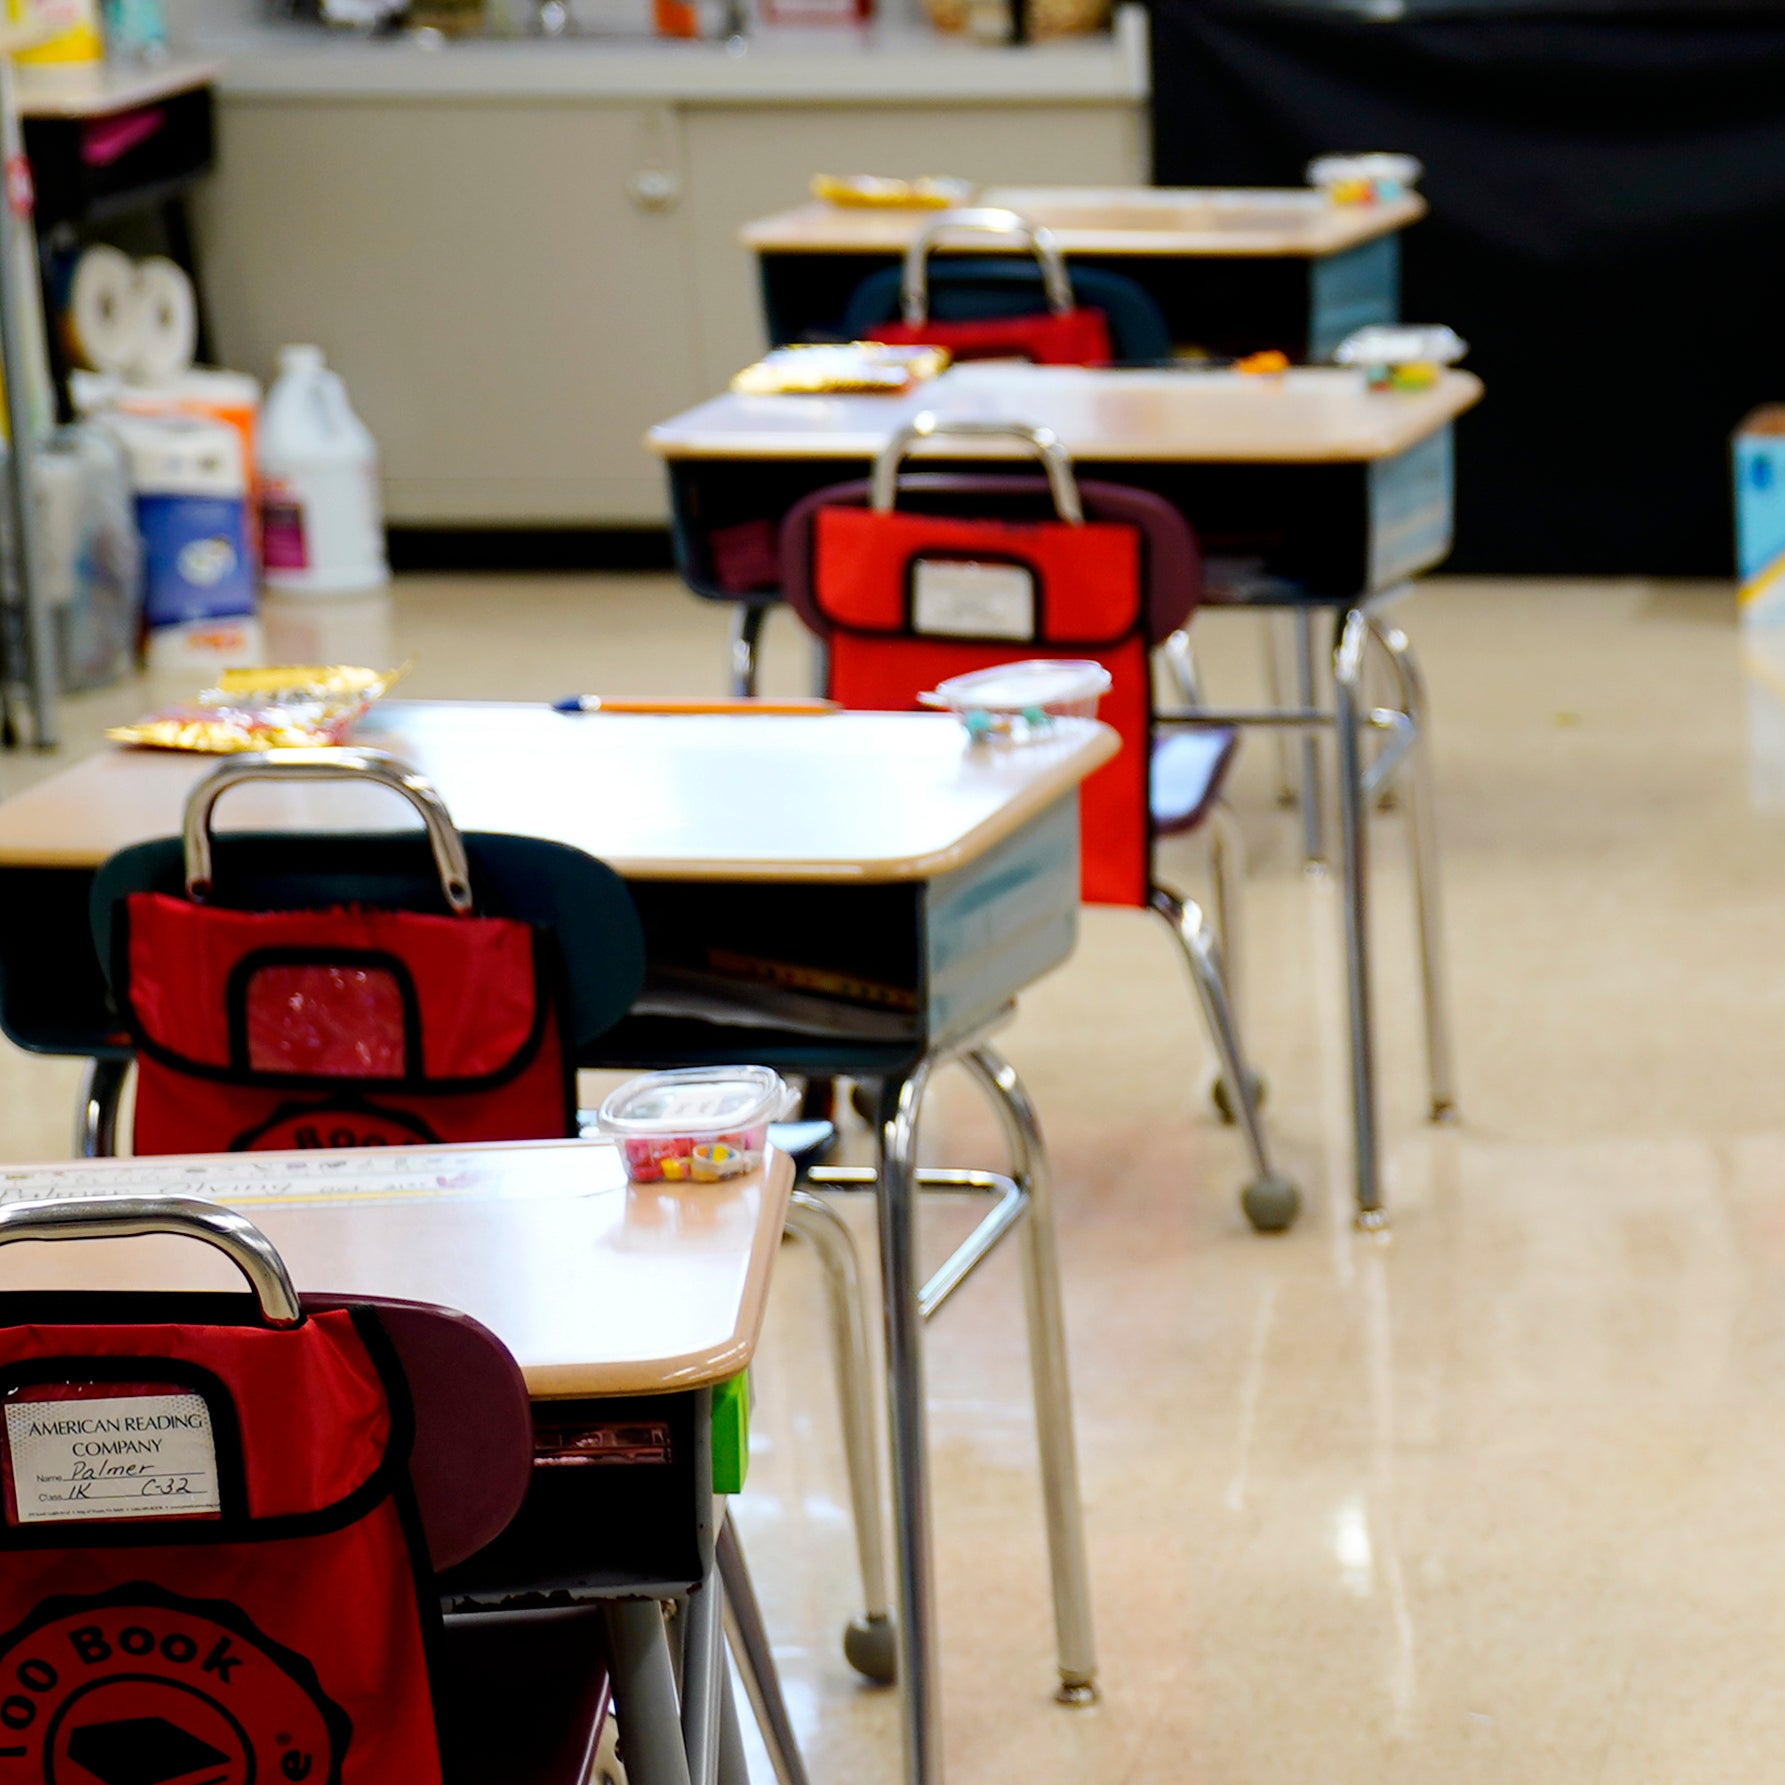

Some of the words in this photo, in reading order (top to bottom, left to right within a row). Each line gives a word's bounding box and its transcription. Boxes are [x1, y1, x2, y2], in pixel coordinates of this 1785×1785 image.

[29, 1418, 120, 1437] AMERICAN
[125, 1413, 203, 1432] READING
[72, 1438, 162, 1458] COMPANY
[71, 1459, 154, 1480] Palmer
[140, 1477, 192, 1498] C-32
[67, 1625, 244, 1684] Book
